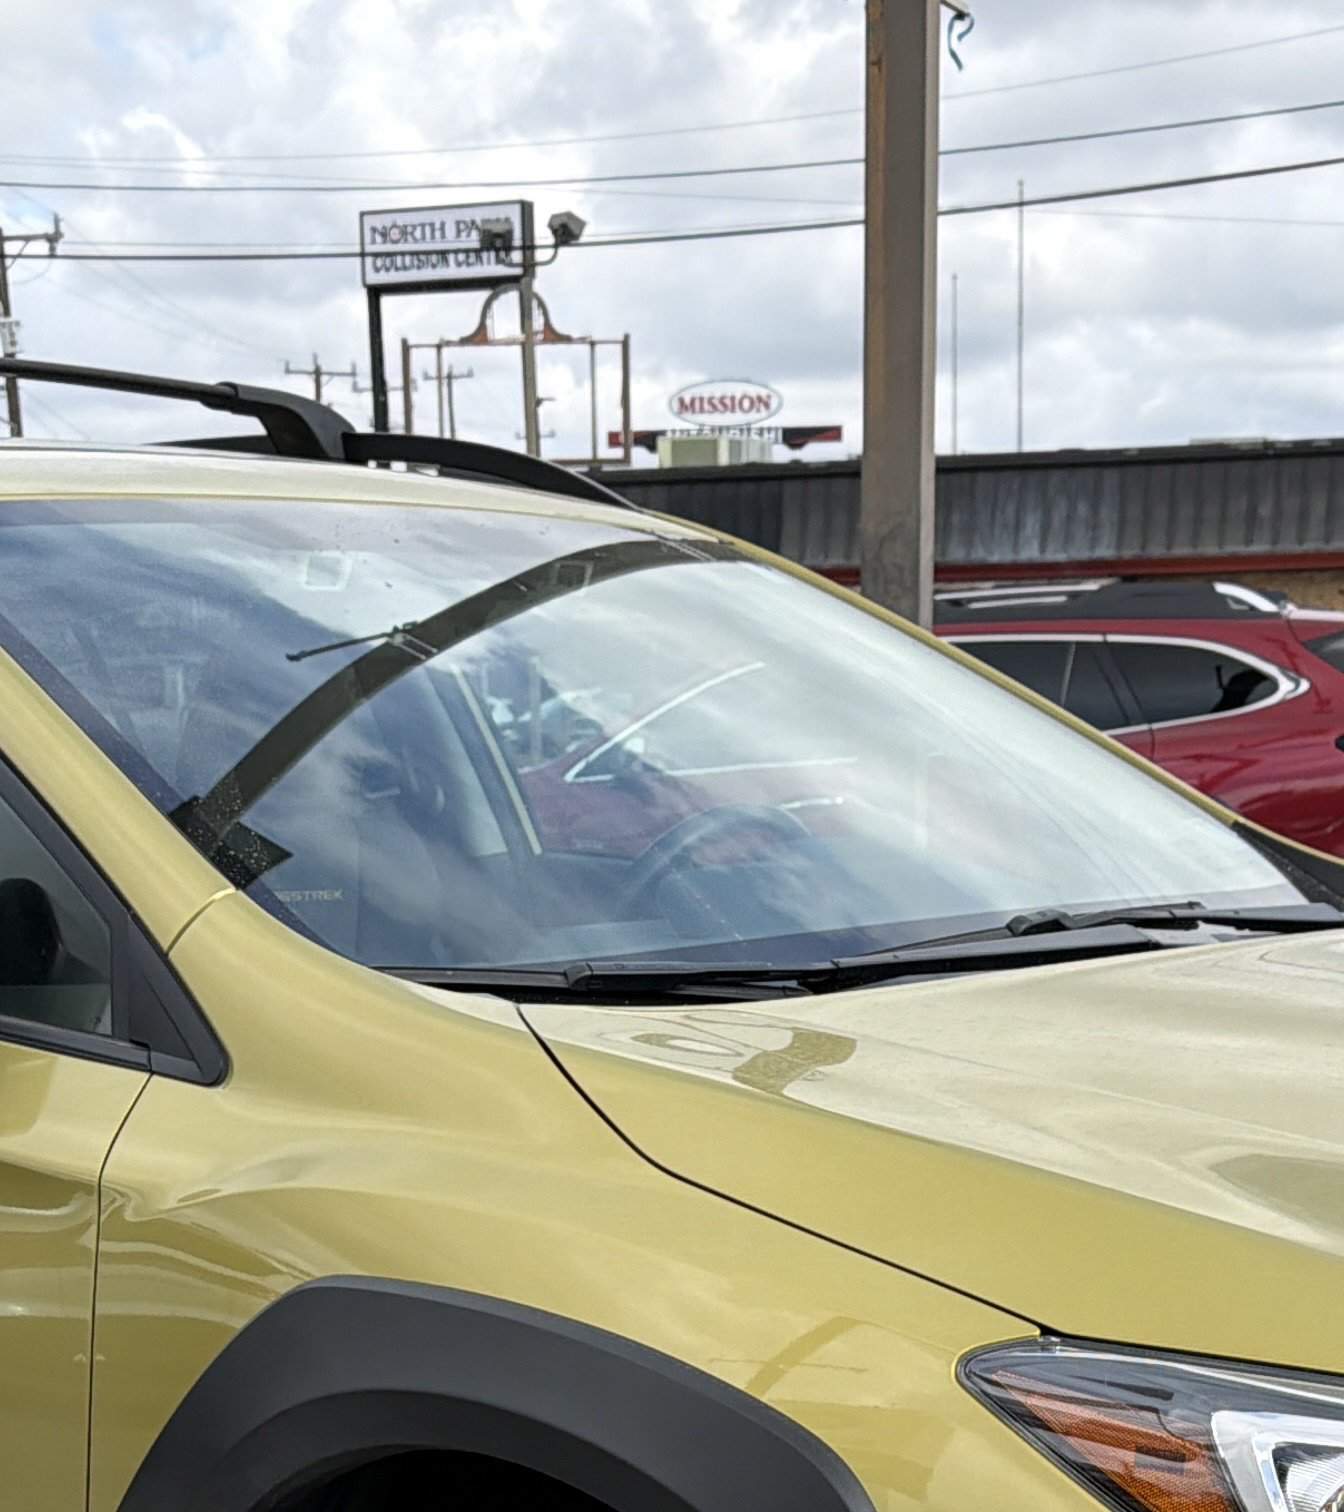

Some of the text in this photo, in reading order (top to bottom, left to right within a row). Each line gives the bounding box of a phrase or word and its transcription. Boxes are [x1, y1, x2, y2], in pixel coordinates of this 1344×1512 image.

[369, 220, 447, 245] NORTH
[371, 251, 451, 273] COLLISION
[676, 391, 773, 416] MISSION
